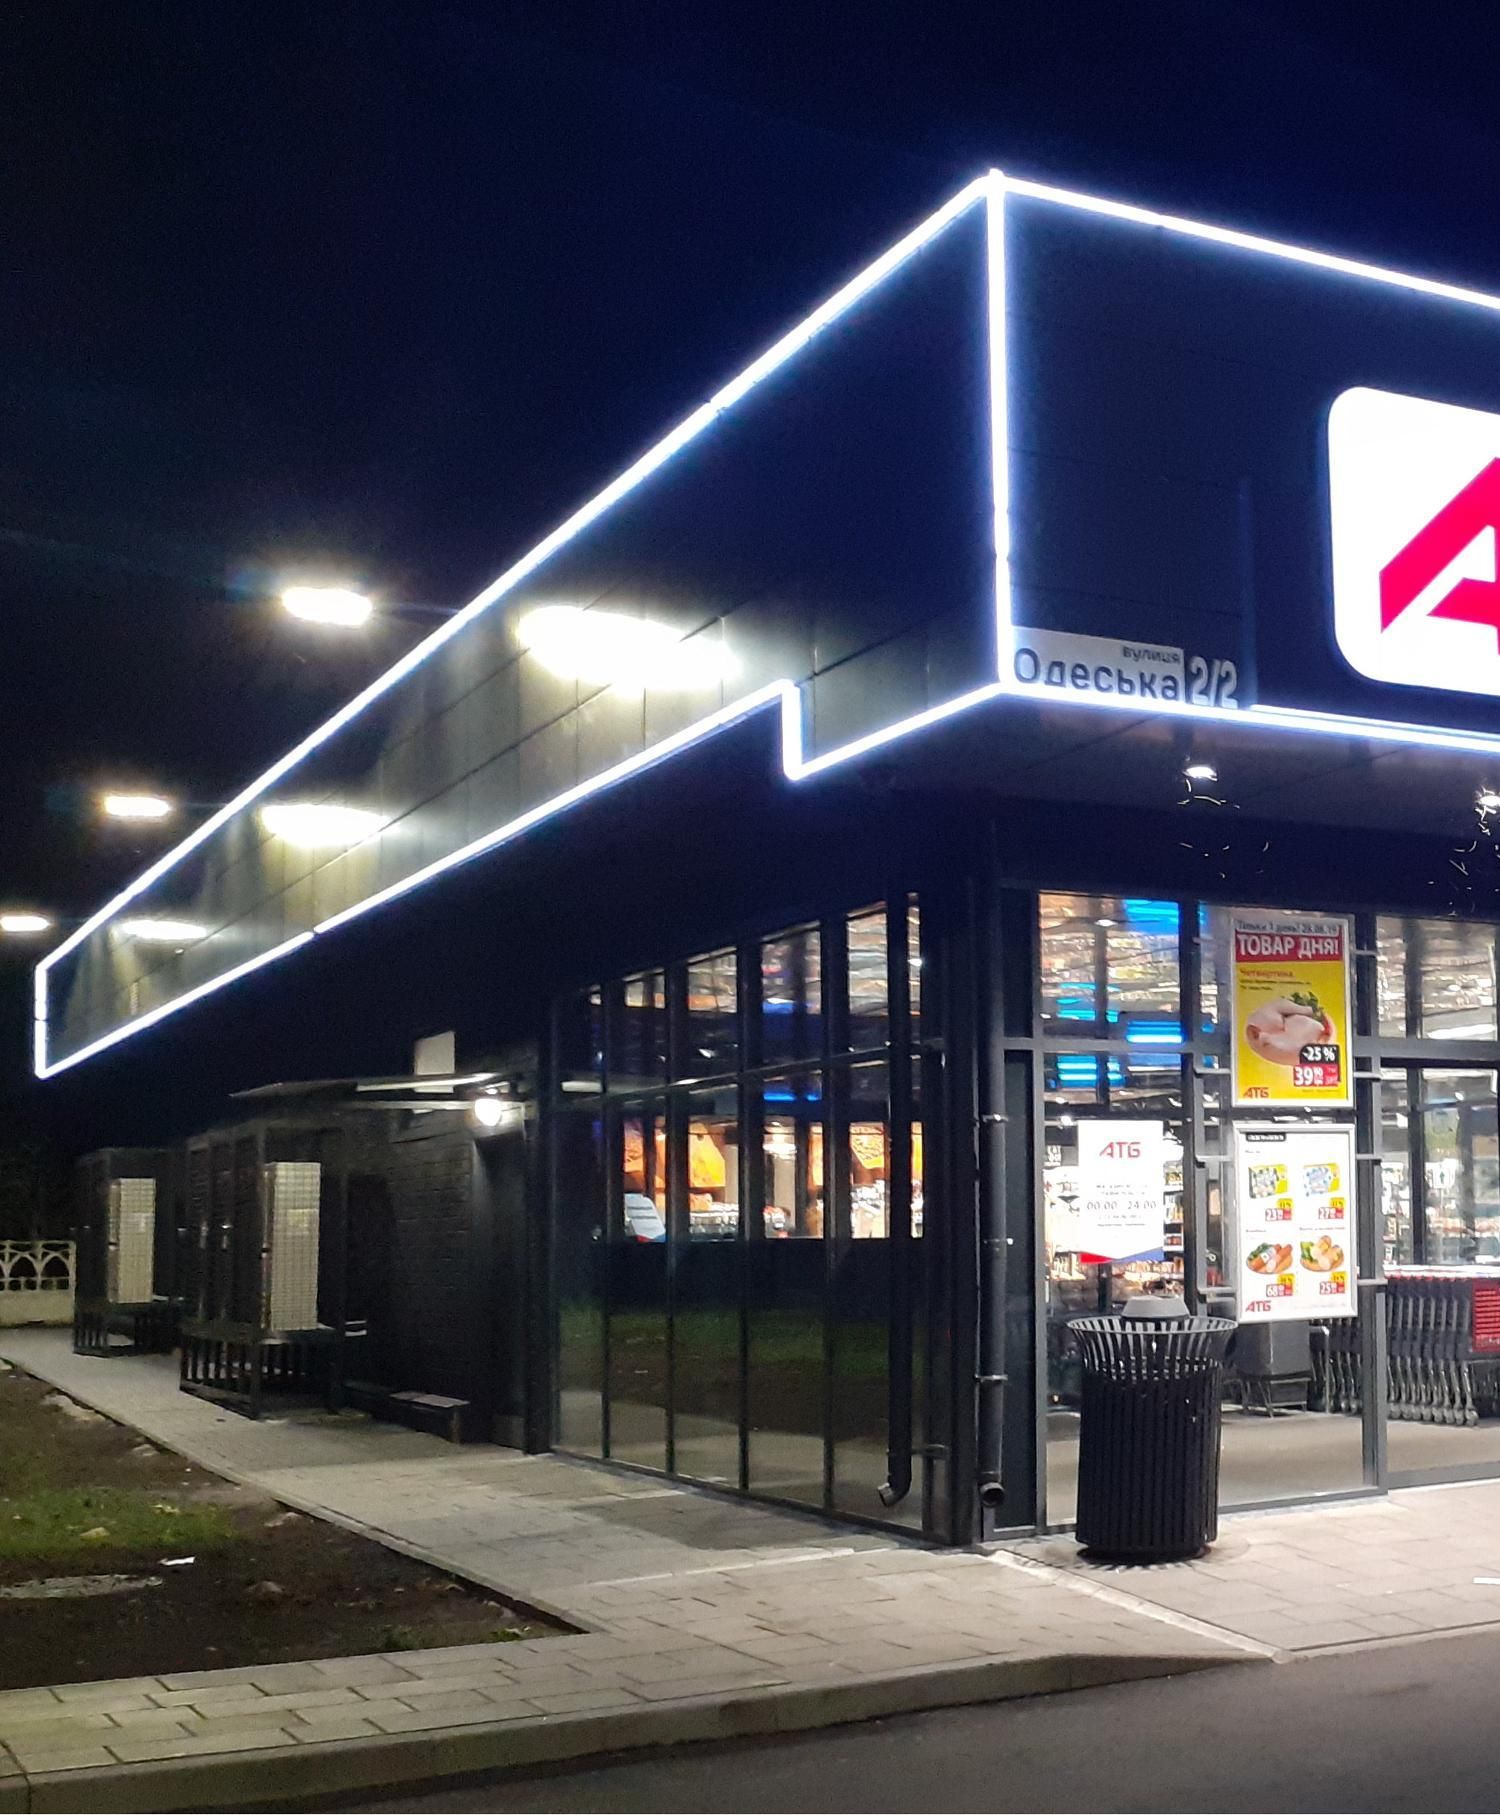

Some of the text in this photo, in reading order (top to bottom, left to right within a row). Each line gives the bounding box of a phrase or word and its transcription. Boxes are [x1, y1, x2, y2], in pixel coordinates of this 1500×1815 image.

[1014, 647, 1181, 702] Одеська
[1190, 655, 1239, 709] 2/2
[1237, 934, 1339, 959] ТОВАР ДНЯ!
[1243, 1087, 1270, 1098] АТБ
[1100, 1141, 1142, 1158] АТБ
[1245, 1300, 1272, 1312] АТБ
